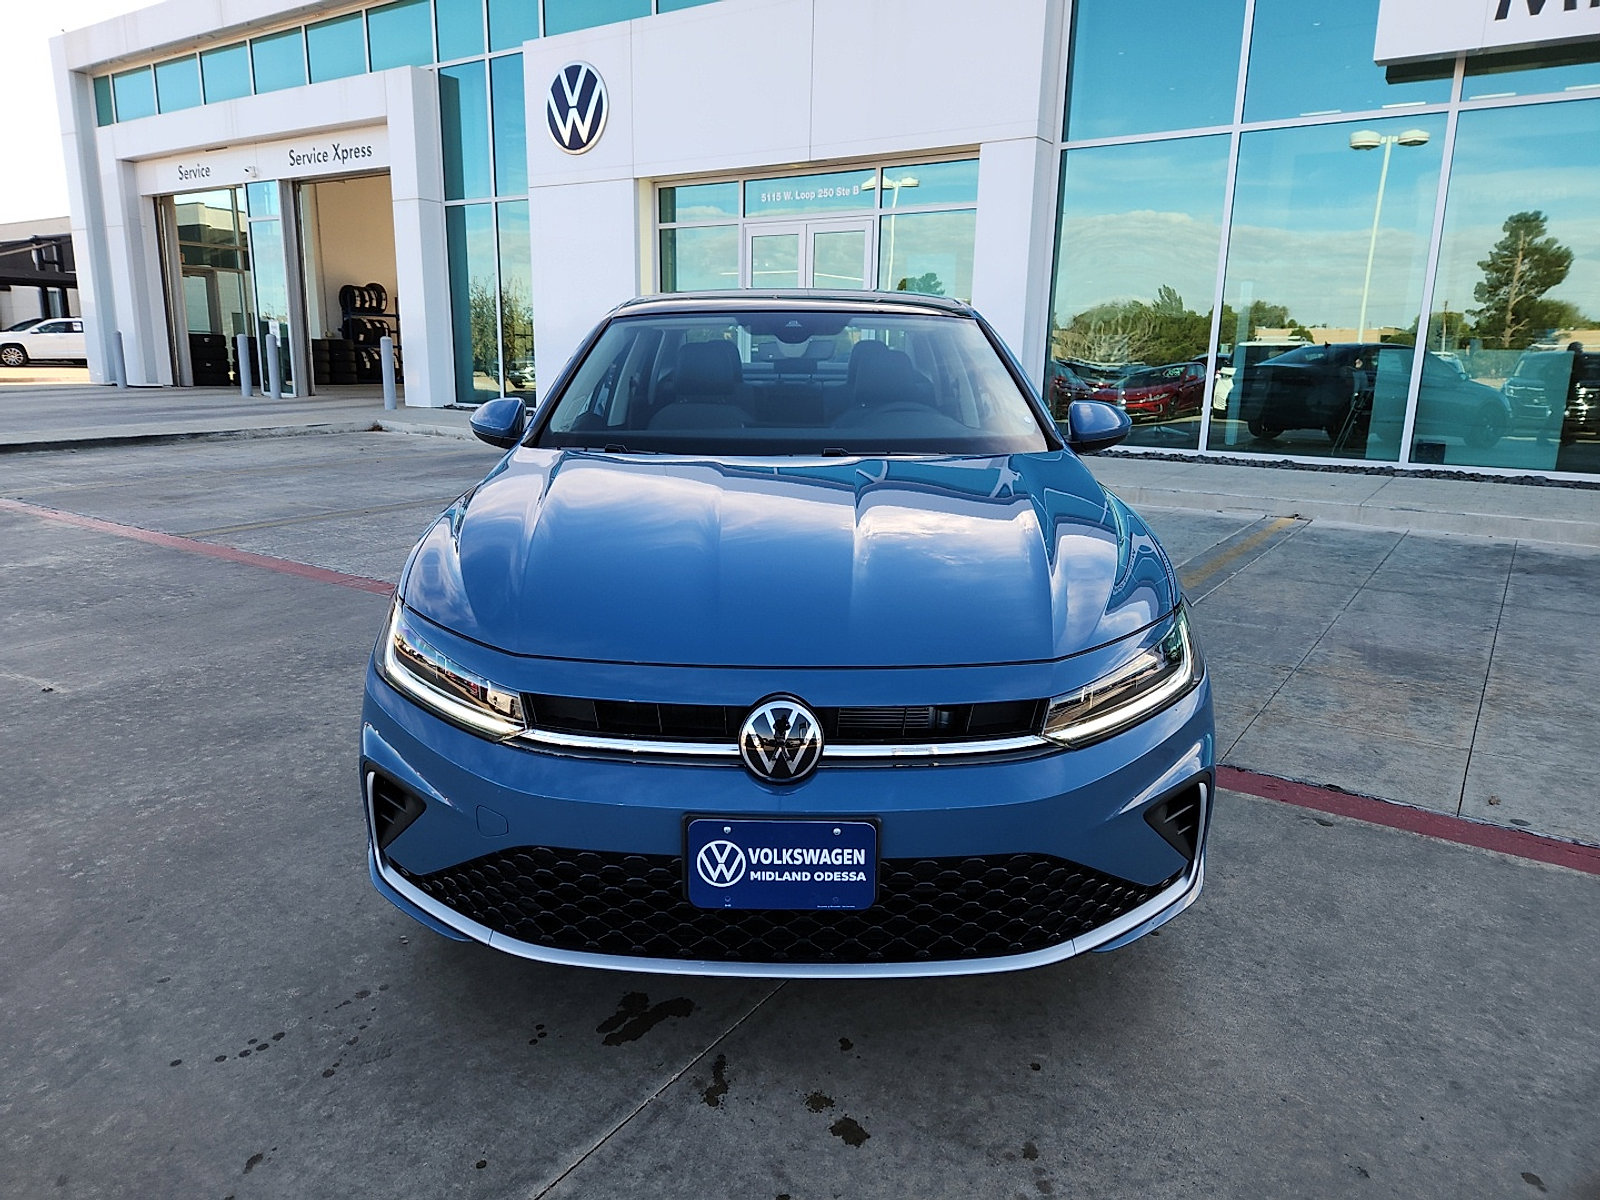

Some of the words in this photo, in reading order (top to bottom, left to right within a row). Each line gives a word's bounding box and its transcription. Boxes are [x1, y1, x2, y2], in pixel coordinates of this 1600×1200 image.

[546, 61, 608, 154] VW
[288, 146, 329, 167] Service
[332, 143, 373, 164] Xpress
[177, 163, 211, 181] Service
[761, 192, 782, 203] 5115
[783, 191, 794, 201] W.
[795, 190, 816, 201] Loop
[818, 187, 834, 198] 250
[836, 186, 851, 197] Ste
[852, 185, 860, 195] B
[740, 700, 822, 781] VW
[697, 840, 747, 888] VW
[748, 848, 866, 865] VOLKSWAGEN
[750, 871, 811, 882] MIDLAND
[814, 871, 866, 882] ODESSA
